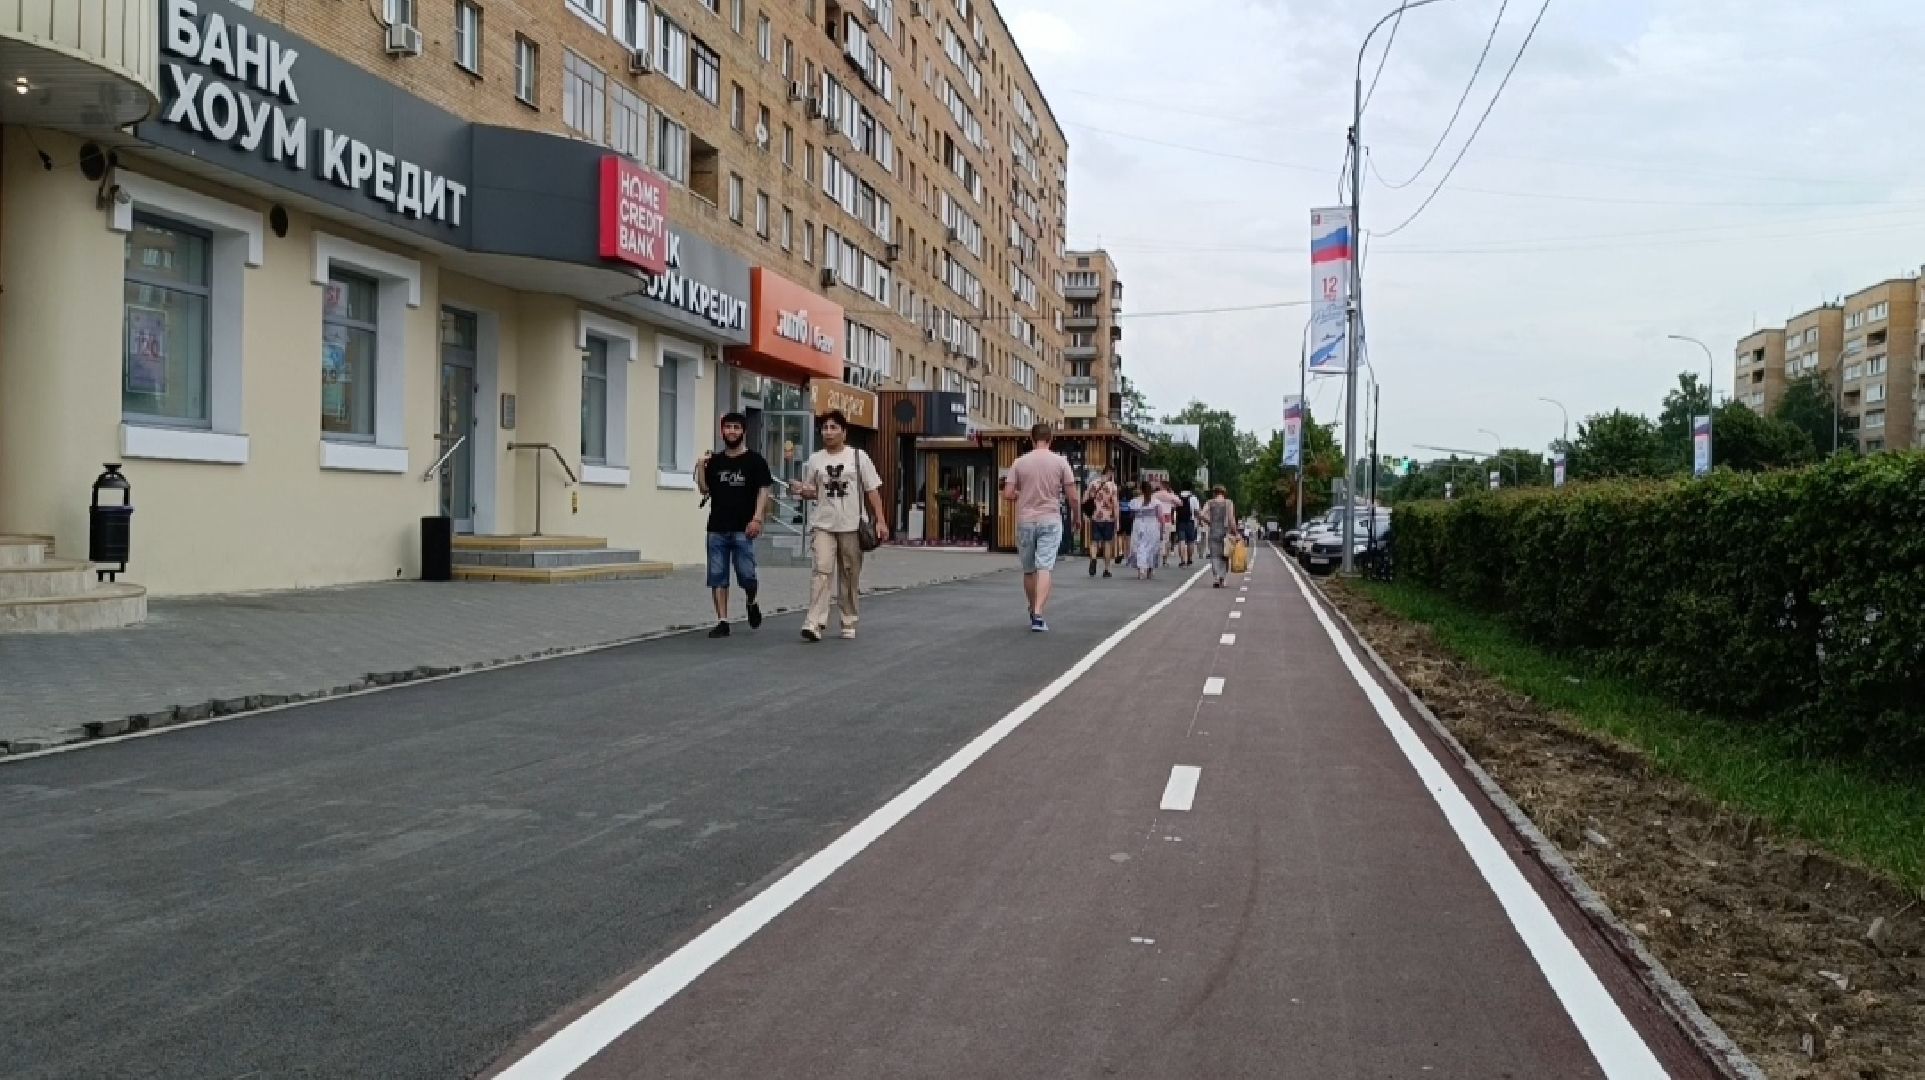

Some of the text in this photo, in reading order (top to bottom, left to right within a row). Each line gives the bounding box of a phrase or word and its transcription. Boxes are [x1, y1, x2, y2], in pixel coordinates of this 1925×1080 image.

[168, 0, 299, 103] БАНК
[167, 63, 466, 227] ХОУМ КРЕДИТ
[621, 170, 660, 210] HOME
[620, 199, 664, 238] CREDIT
[619, 225, 655, 260] BANK
[688, 278, 747, 330] КРЕДИТ
[1322, 276, 1338, 294] 12
